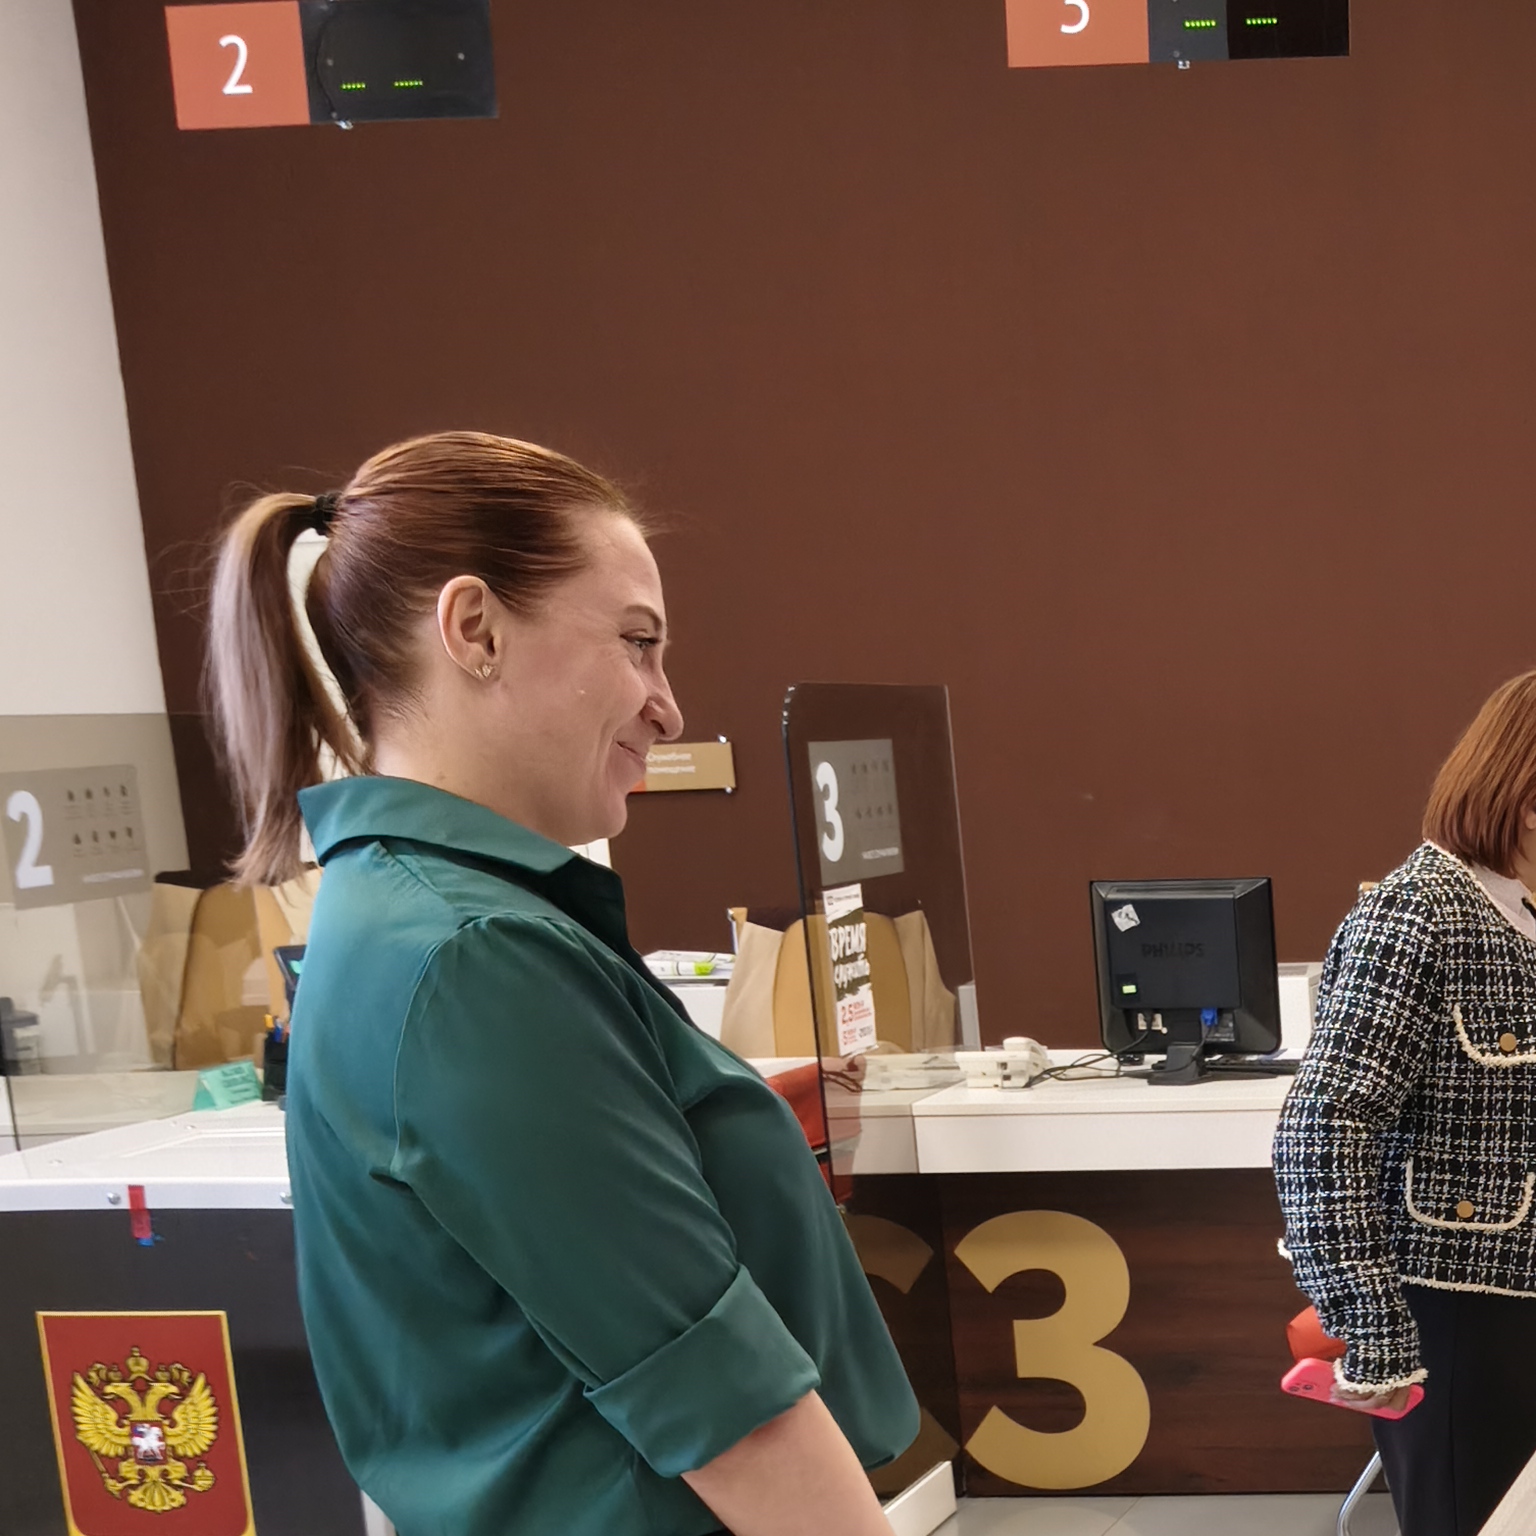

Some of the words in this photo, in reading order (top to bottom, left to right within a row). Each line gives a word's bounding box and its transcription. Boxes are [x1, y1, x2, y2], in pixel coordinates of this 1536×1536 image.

[219, 35, 254, 95] 2
[7, 790, 54, 889] 2
[815, 761, 845, 862] 3
[829, 923, 867, 962] ВРЕМЯ
[1141, 943, 1205, 959] PHILIPS
[954, 1209, 1150, 1490] 3
